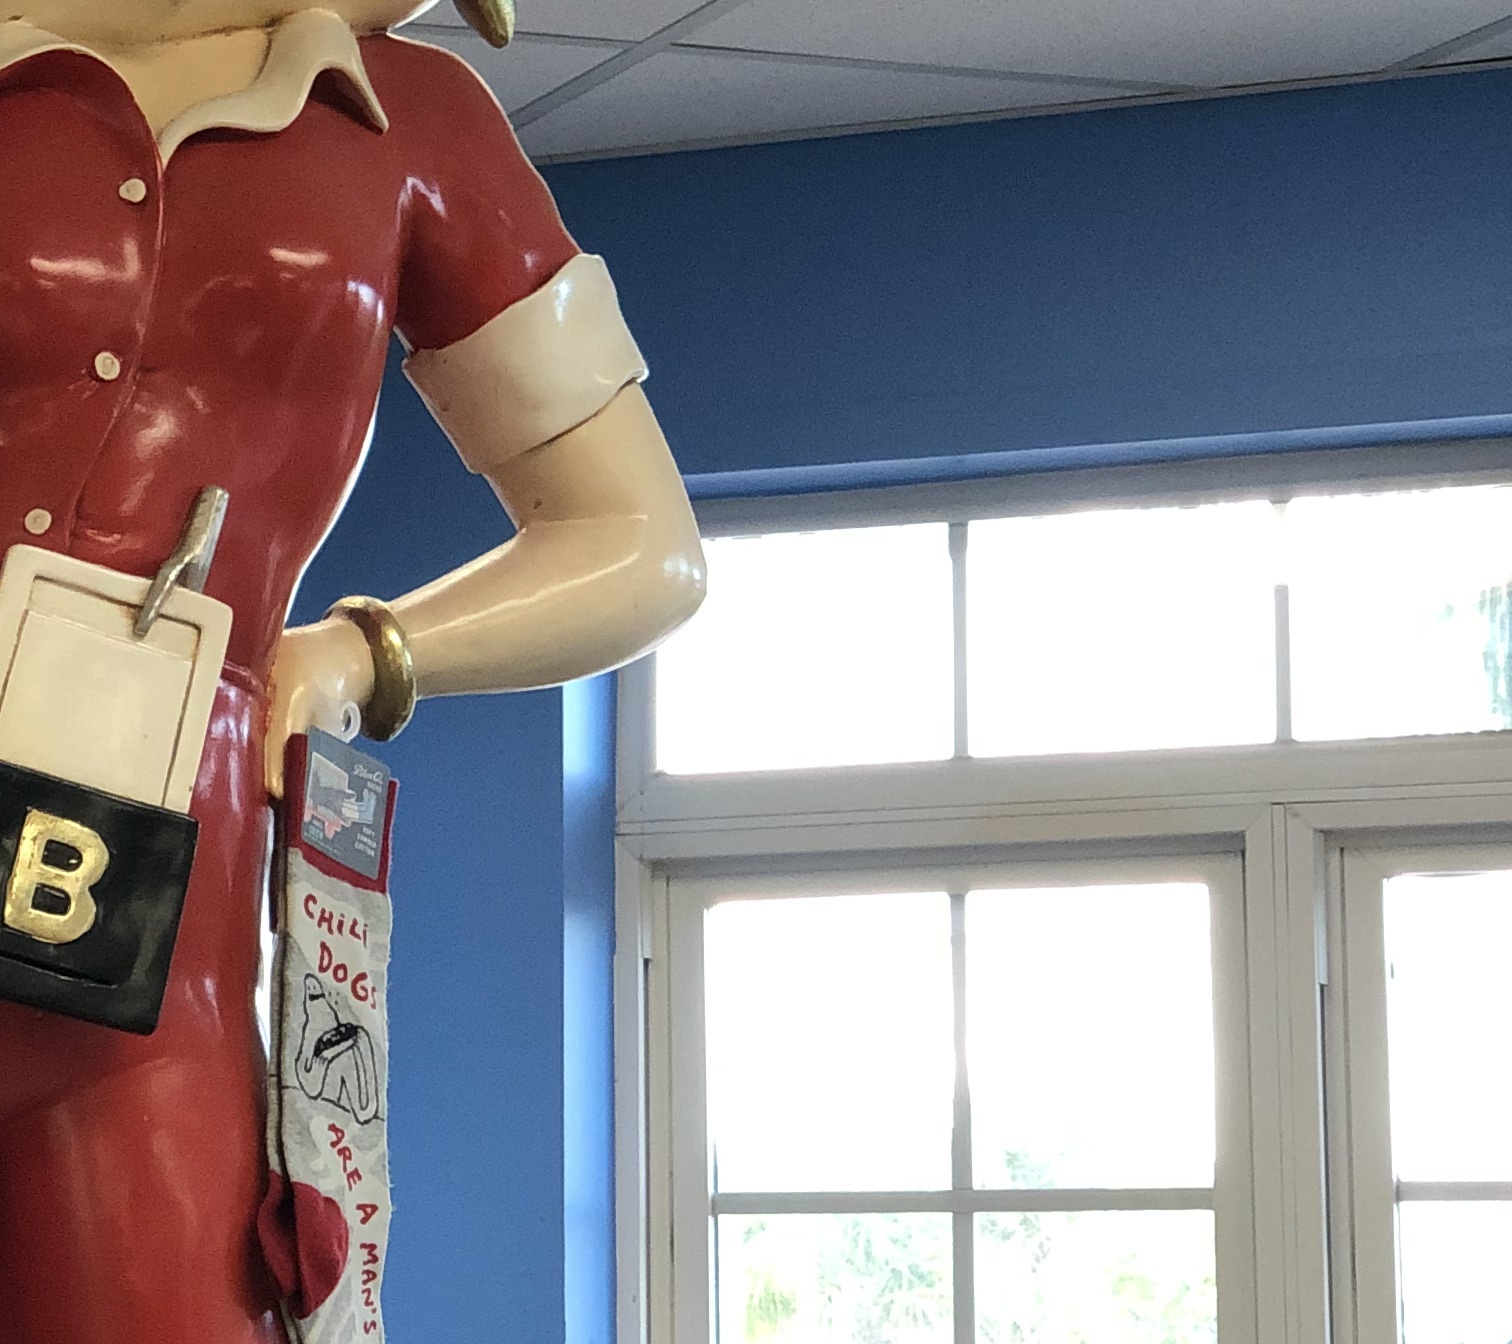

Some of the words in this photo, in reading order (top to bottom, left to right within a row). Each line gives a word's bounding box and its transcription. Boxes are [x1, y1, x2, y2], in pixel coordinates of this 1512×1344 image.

[4, 807, 109, 944] B
[318, 941, 377, 1010] DOGS
[328, 1123, 362, 1190] ARE
[356, 1203, 379, 1225] A
[359, 1243, 379, 1335] MAN'S
